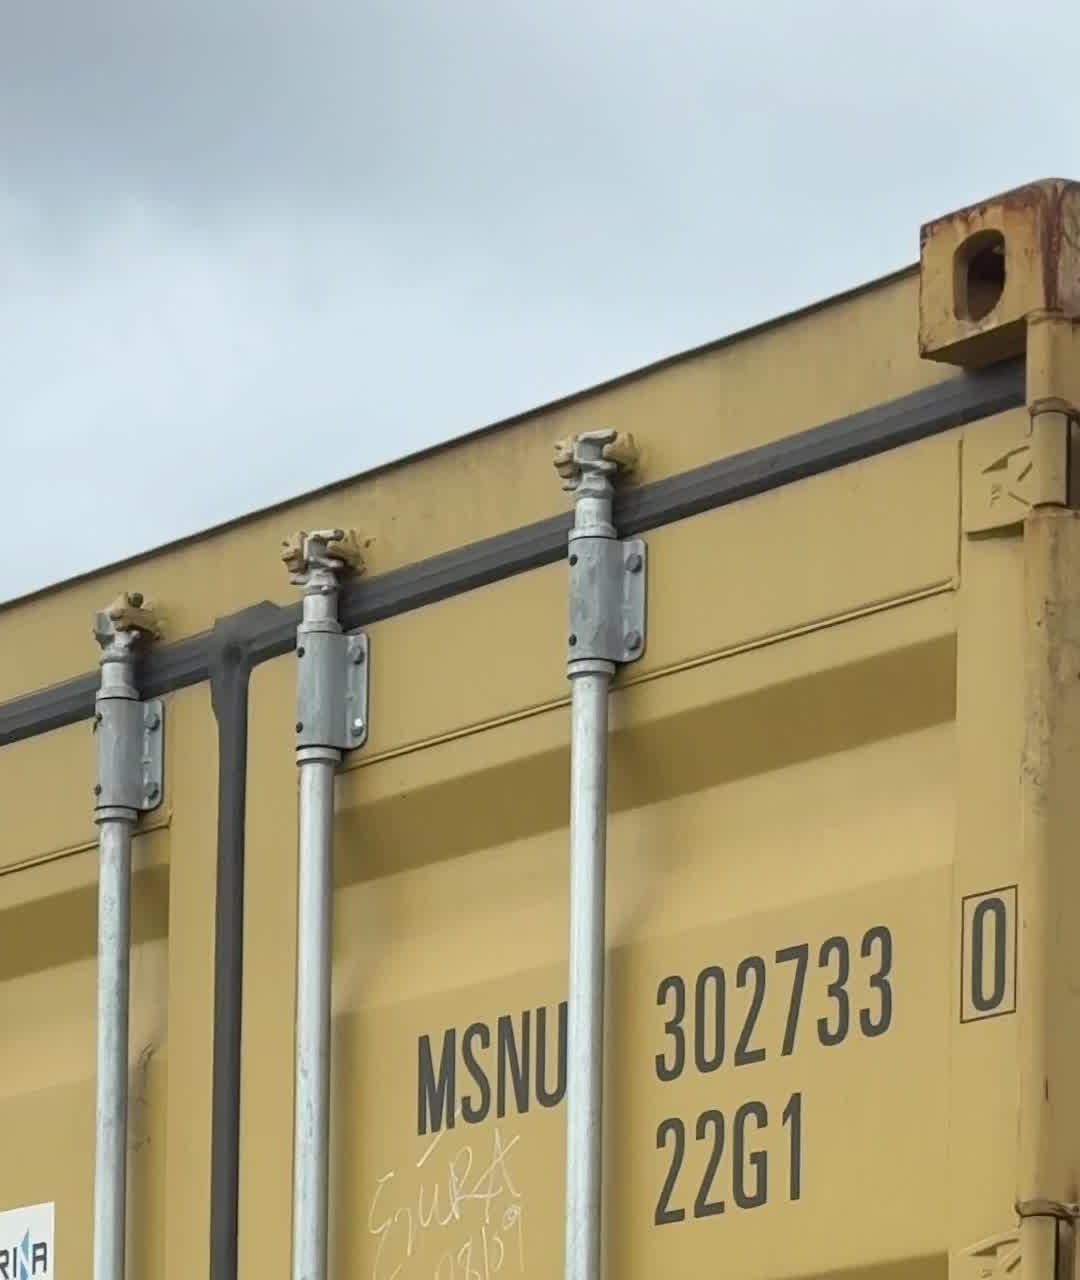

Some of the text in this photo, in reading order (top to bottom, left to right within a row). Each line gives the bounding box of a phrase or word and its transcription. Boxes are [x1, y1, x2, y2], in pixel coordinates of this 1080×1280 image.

[417, 897, 1007, 1135] MSNU 302733 0
[654, 1092, 802, 1225] 22G1
